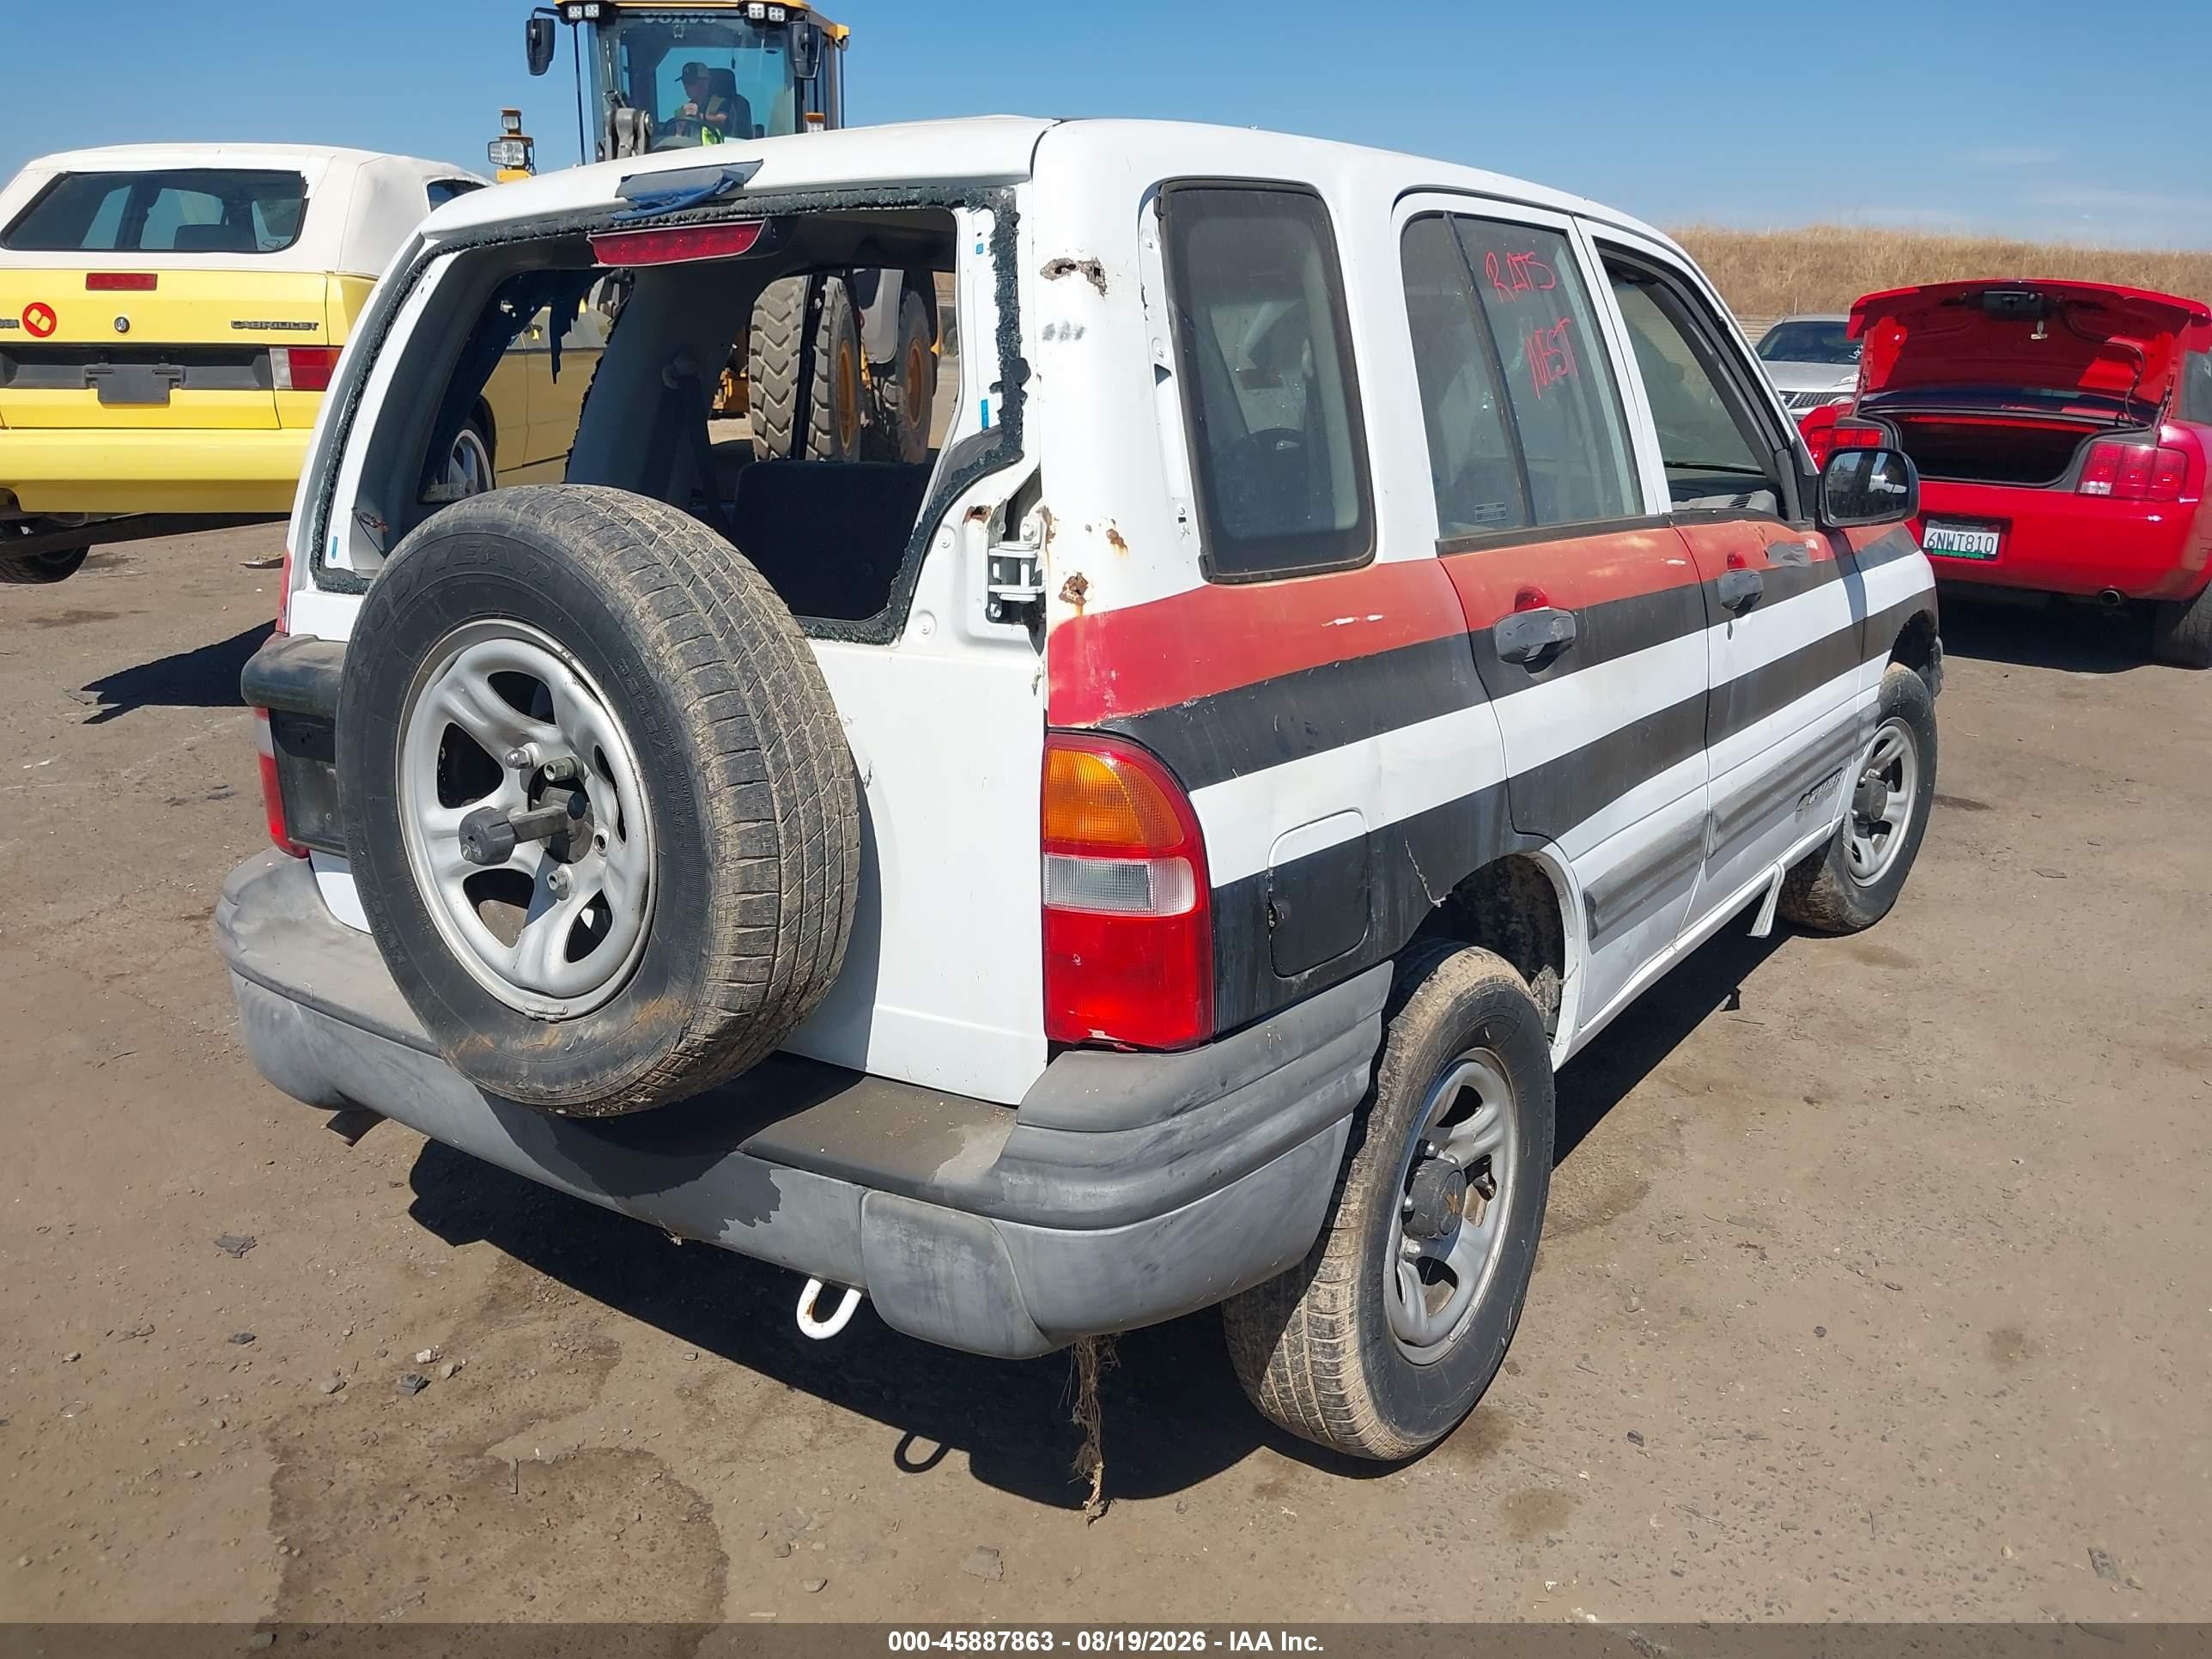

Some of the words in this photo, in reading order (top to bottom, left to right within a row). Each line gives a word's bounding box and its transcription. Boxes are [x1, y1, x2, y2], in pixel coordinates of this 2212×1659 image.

[640, 13, 716, 24] VOLVO
[1524, 317, 1578, 400] NEST
[1926, 532, 1995, 554] 6NWT810
